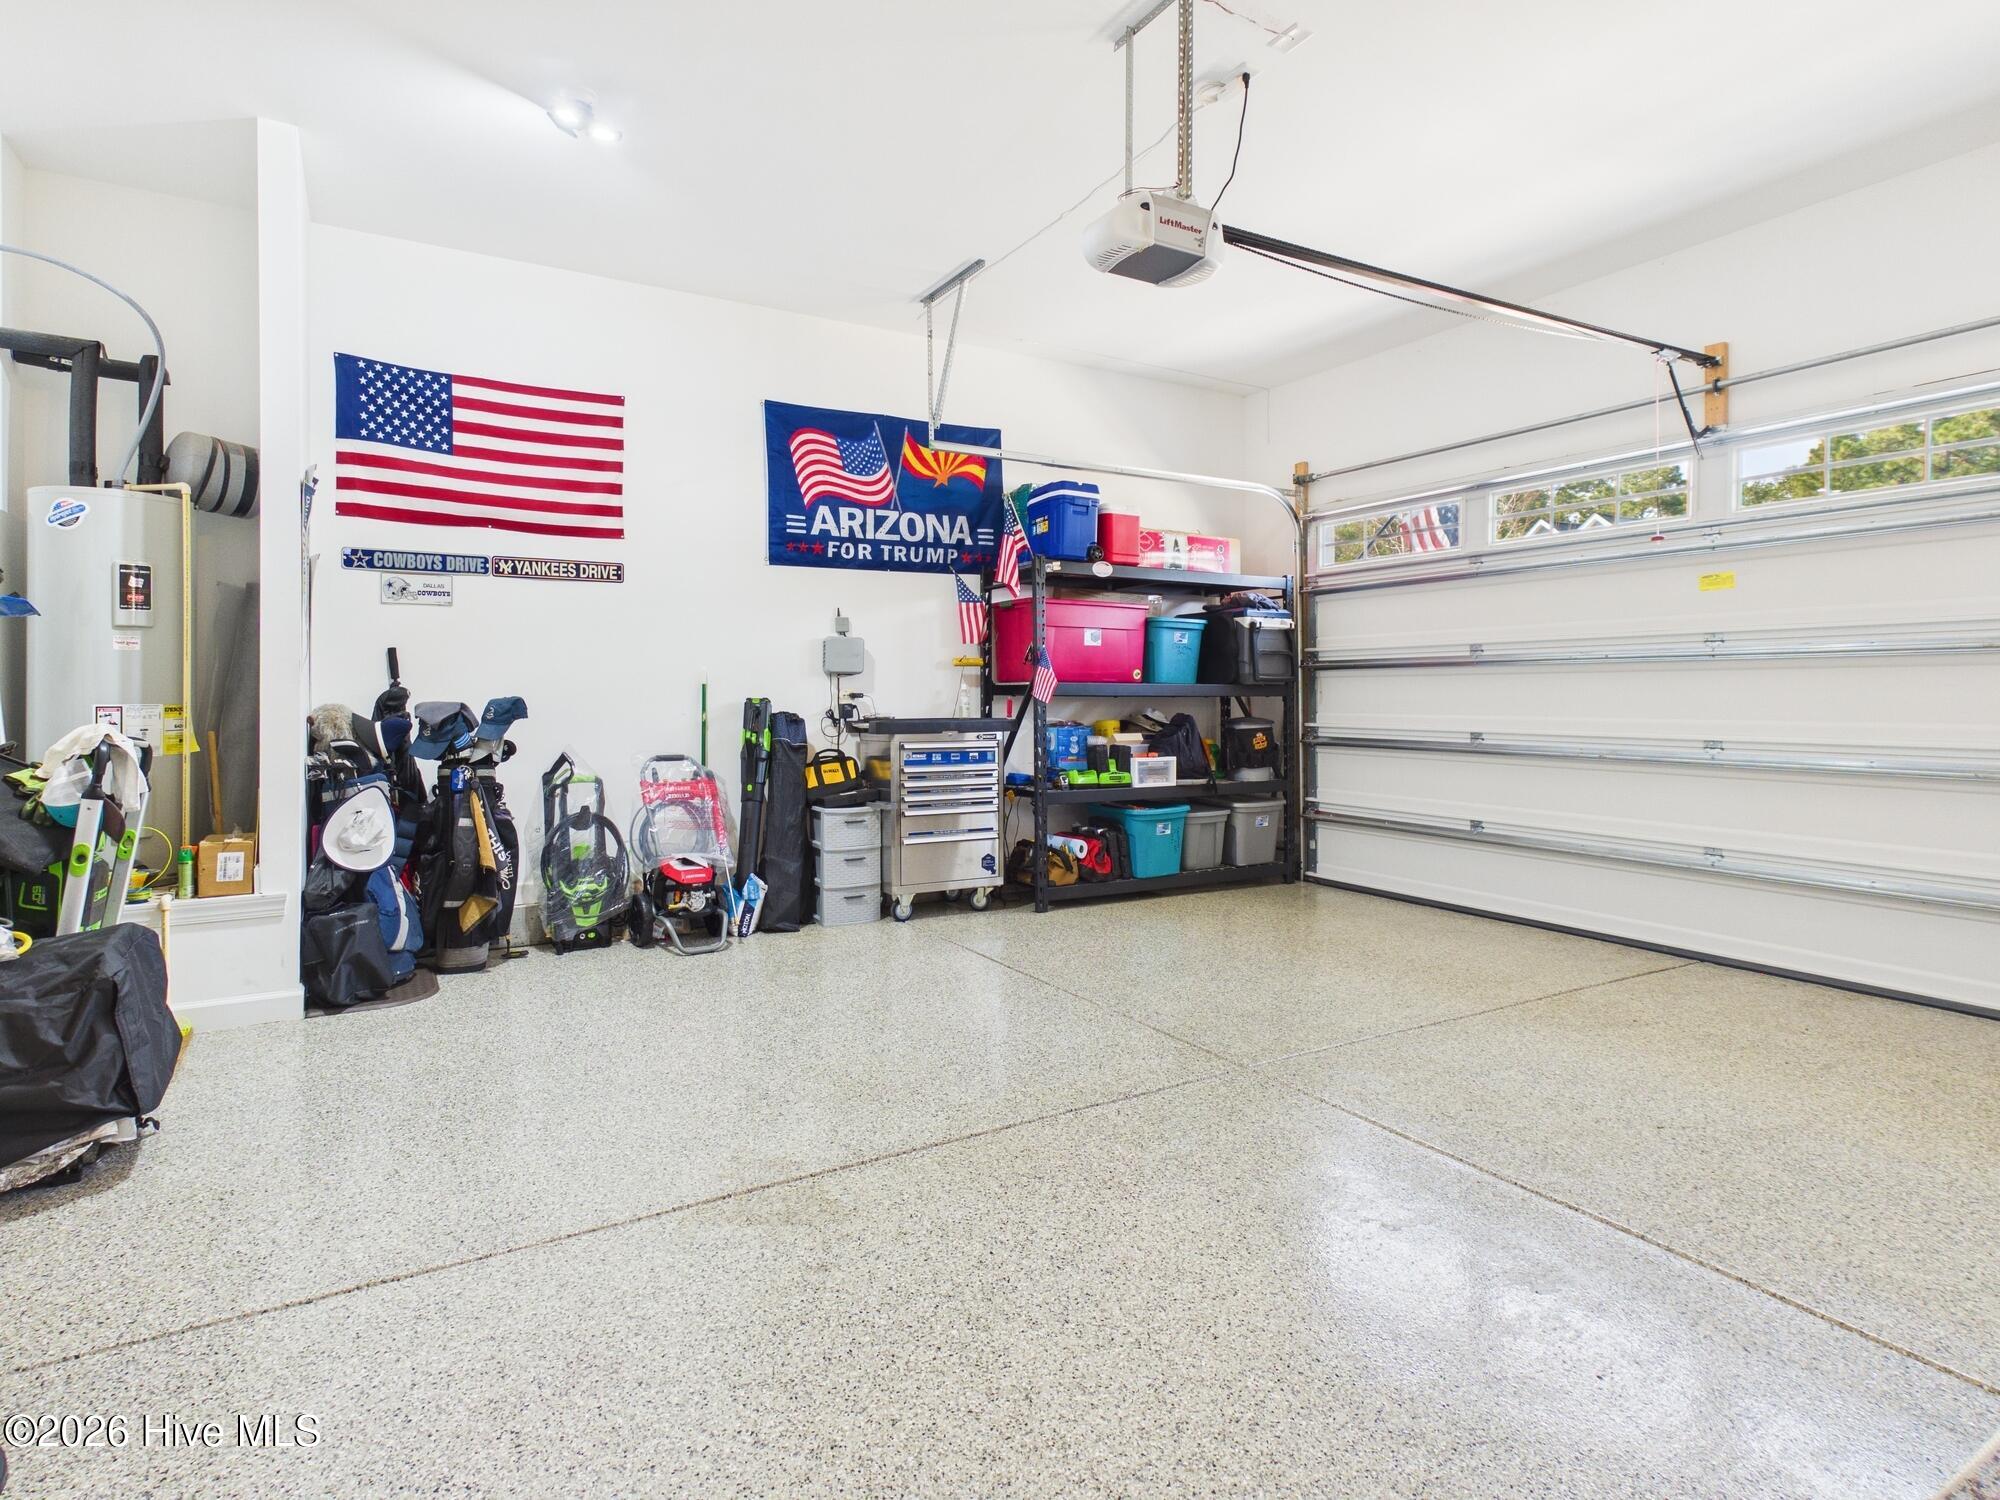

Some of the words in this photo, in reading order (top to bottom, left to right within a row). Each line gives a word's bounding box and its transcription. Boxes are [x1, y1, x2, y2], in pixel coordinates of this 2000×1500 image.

[1159, 216, 1203, 235] LiftMaster
[810, 505, 973, 546] ARIZONA
[373, 551, 443, 571] COWBOYS
[446, 556, 486, 573] DRIVE
[827, 541, 873, 560] FOR
[880, 545, 958, 564] TRUMP
[514, 560, 577, 578] YANKEES
[580, 564, 618, 580] DRIVE
